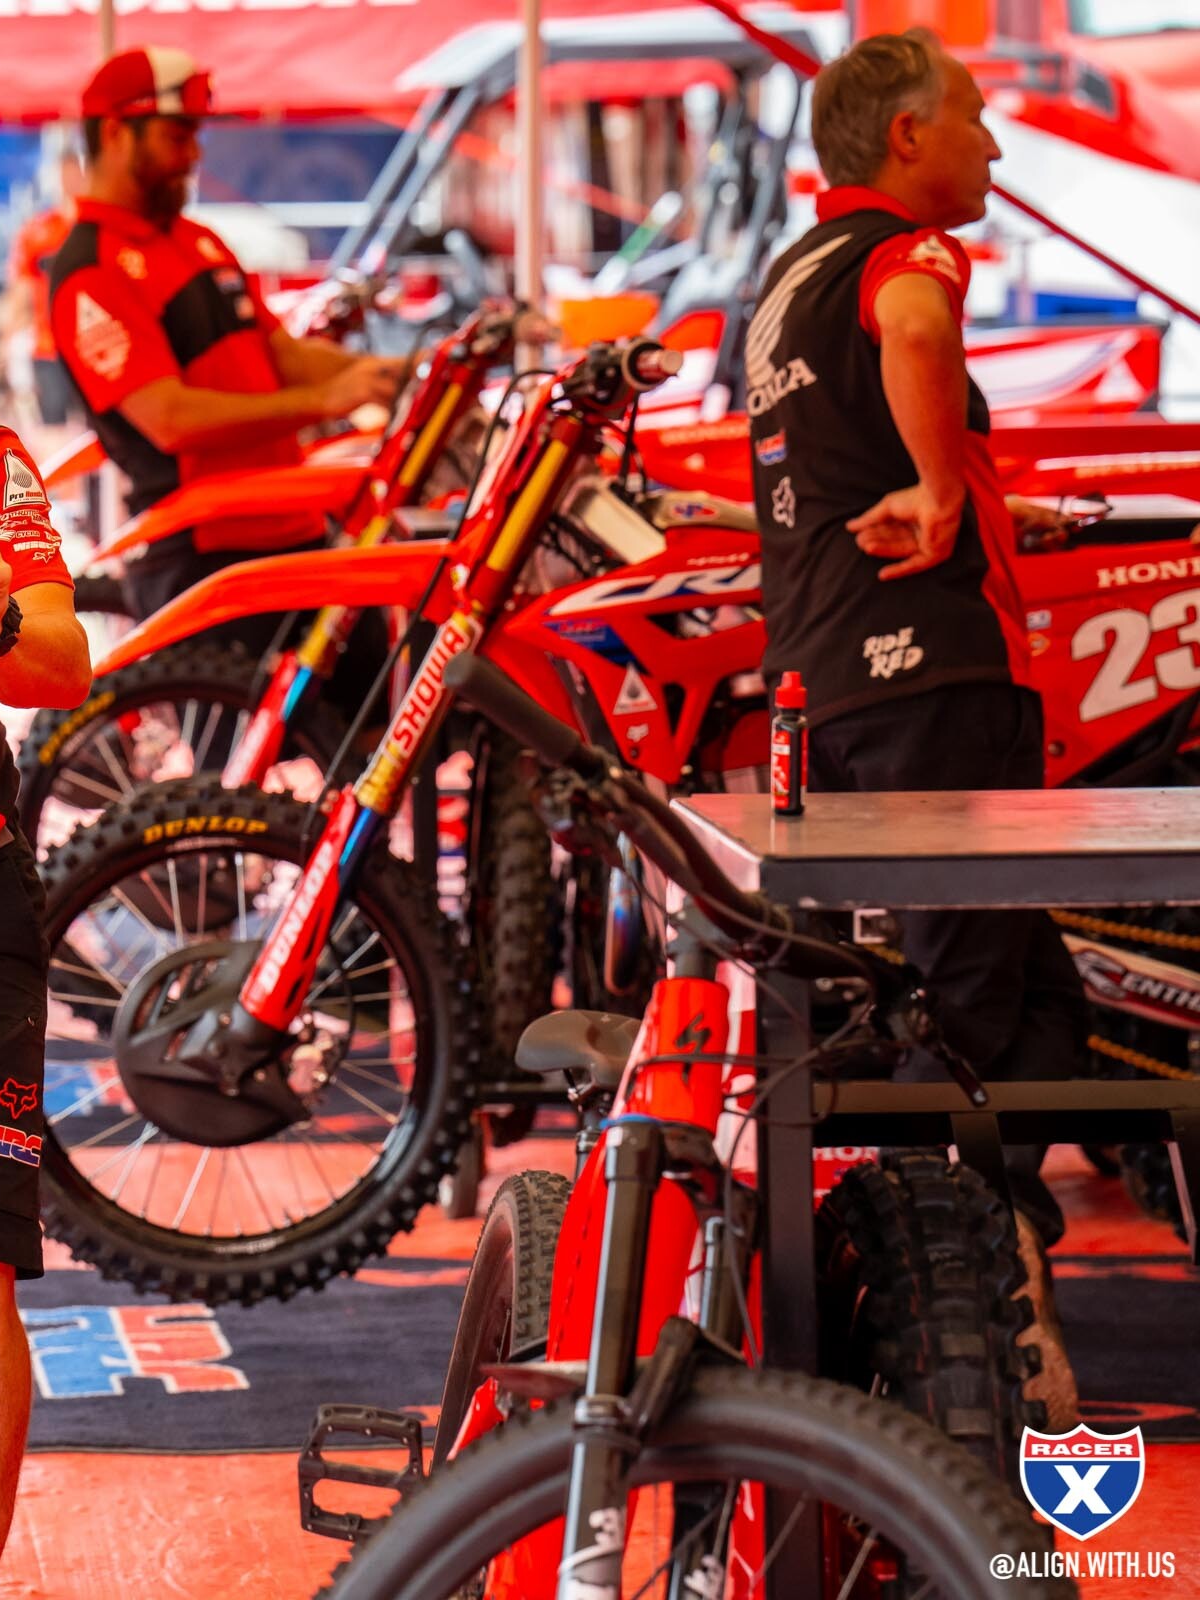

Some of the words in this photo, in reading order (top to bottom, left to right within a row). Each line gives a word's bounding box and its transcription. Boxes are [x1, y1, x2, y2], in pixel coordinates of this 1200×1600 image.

[1096, 557, 1200, 588] HON
[863, 626, 915, 658] RIDE
[869, 646, 924, 680] RED
[144, 816, 269, 844] DUNLOP
